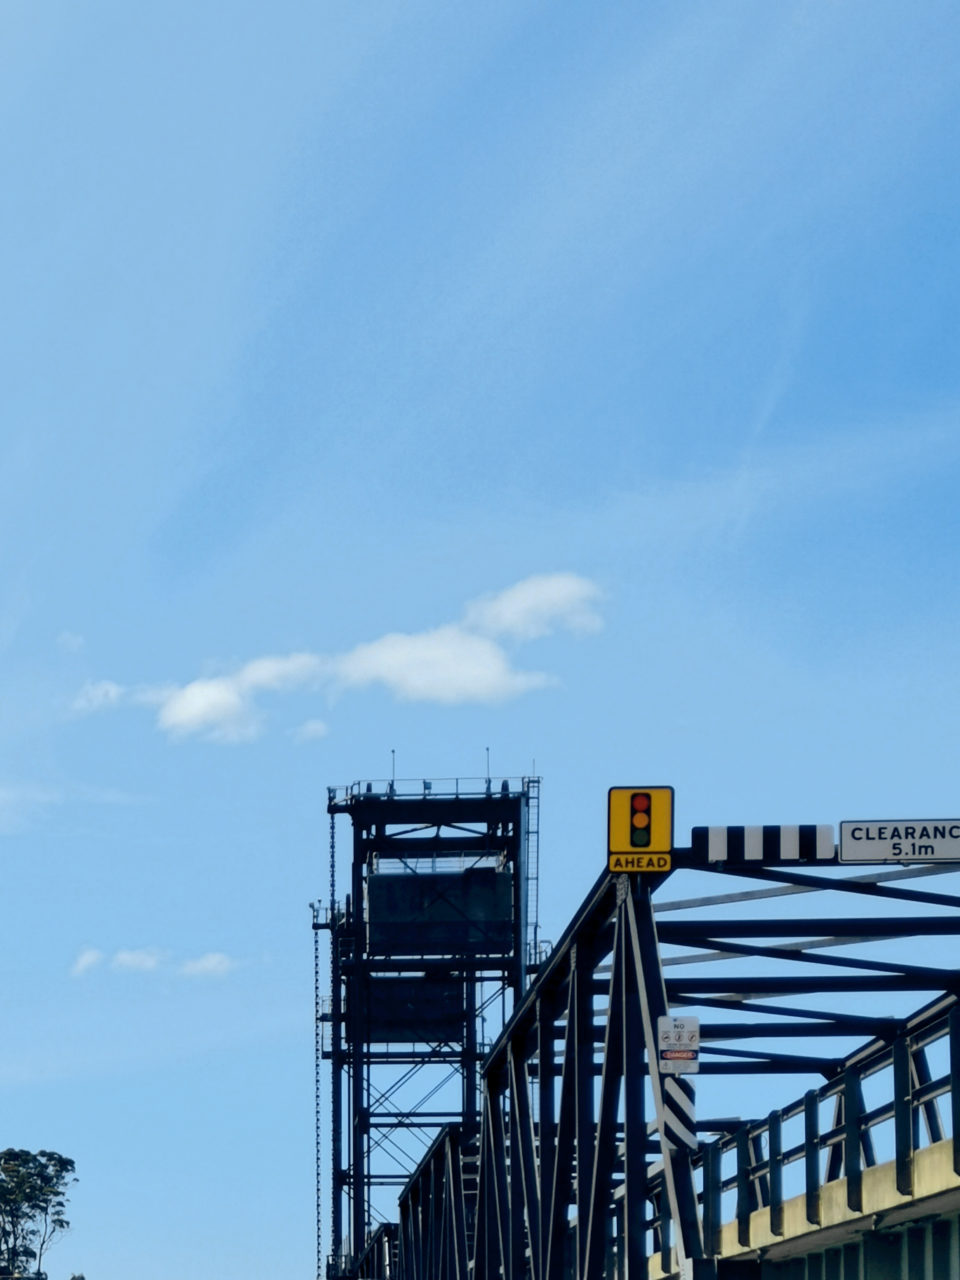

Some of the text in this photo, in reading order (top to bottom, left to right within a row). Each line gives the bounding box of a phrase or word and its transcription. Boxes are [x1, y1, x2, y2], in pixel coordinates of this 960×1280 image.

[851, 826, 960, 840] CLEARANC
[892, 843, 935, 856] 5.1m
[613, 857, 668, 868] AHEAD
